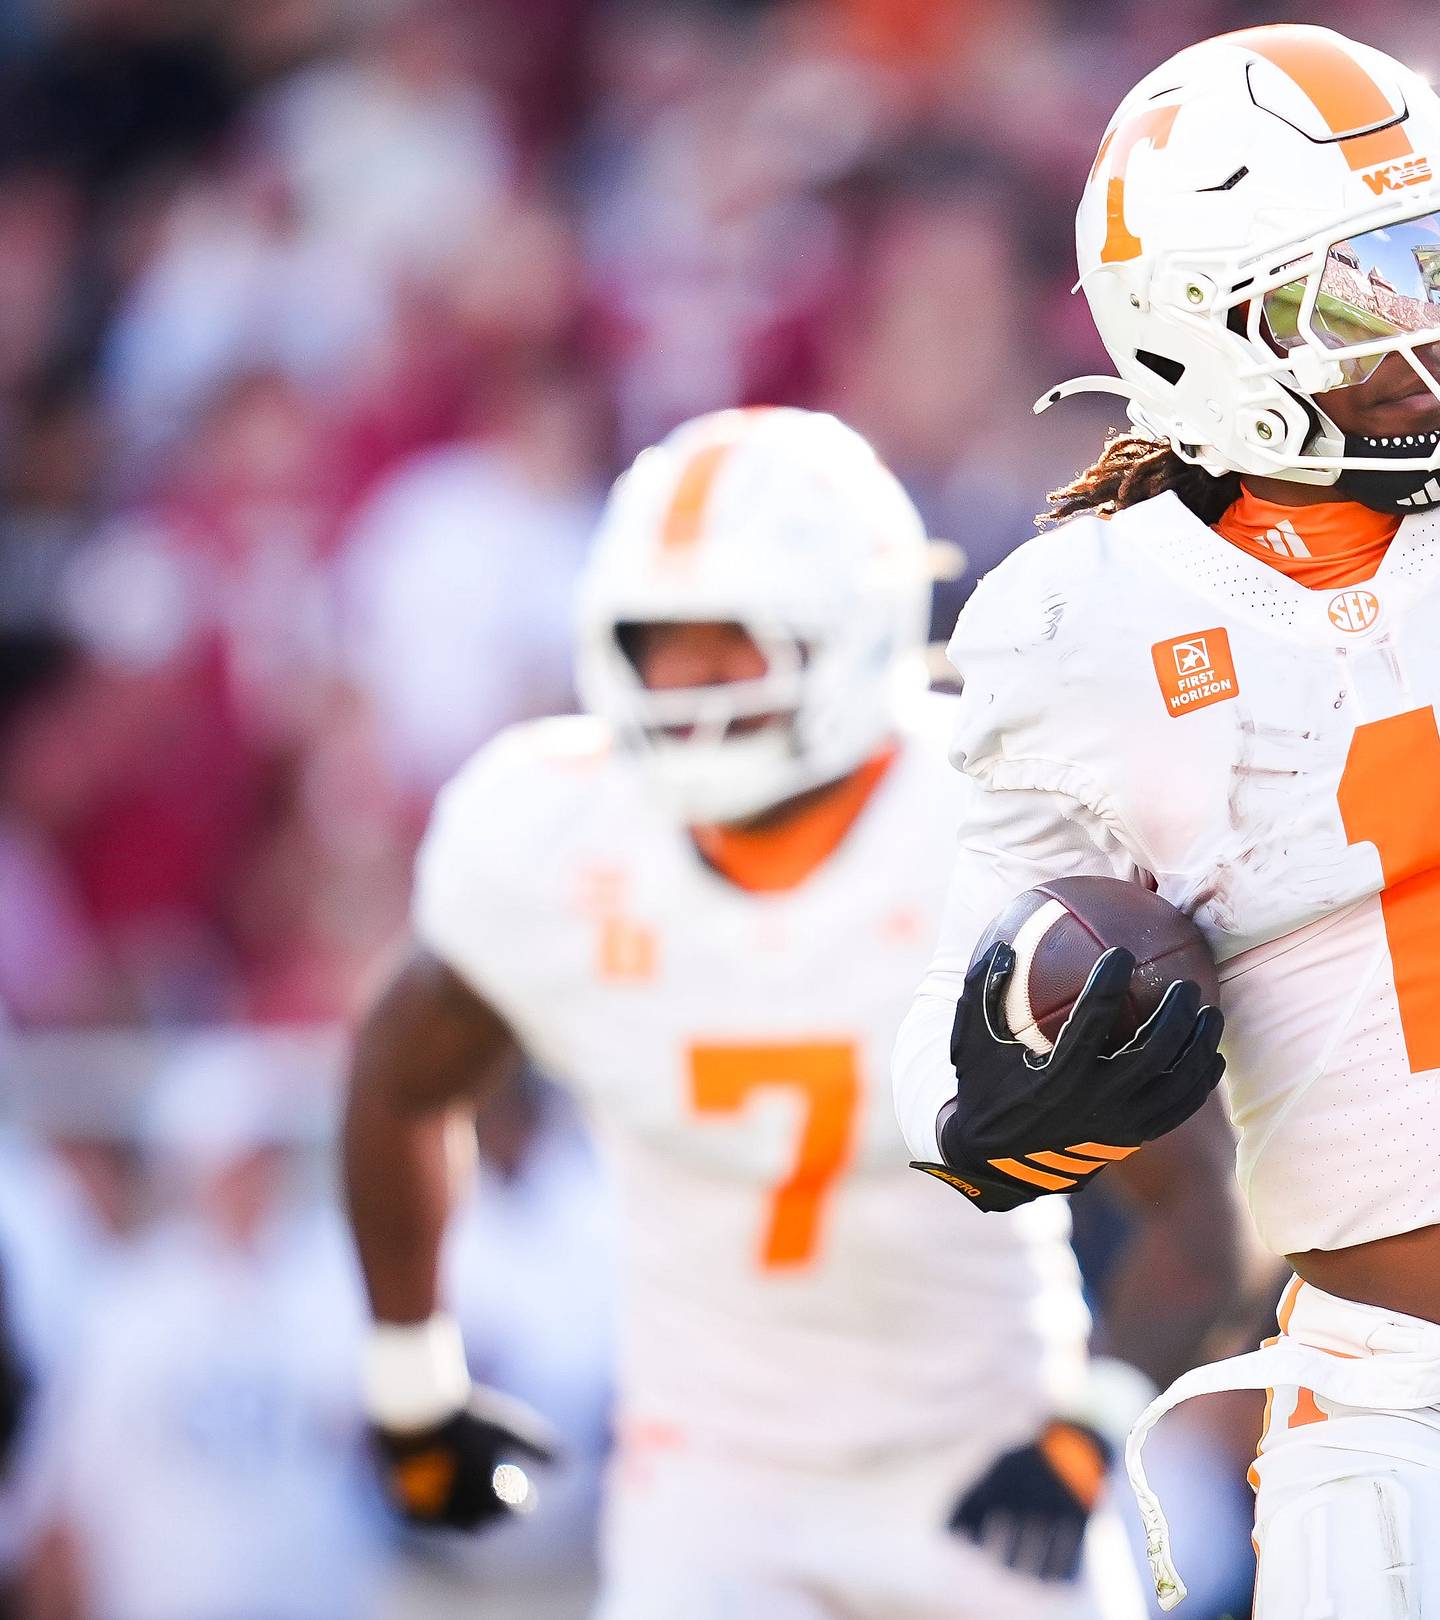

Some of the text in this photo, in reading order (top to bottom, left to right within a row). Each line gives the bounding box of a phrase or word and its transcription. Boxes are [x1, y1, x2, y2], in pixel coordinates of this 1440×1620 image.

[1329, 591, 1378, 632] SEC
[1170, 679, 1232, 708] HORIZON
[1177, 670, 1216, 691] FIRST
[685, 1037, 860, 1274] 7
